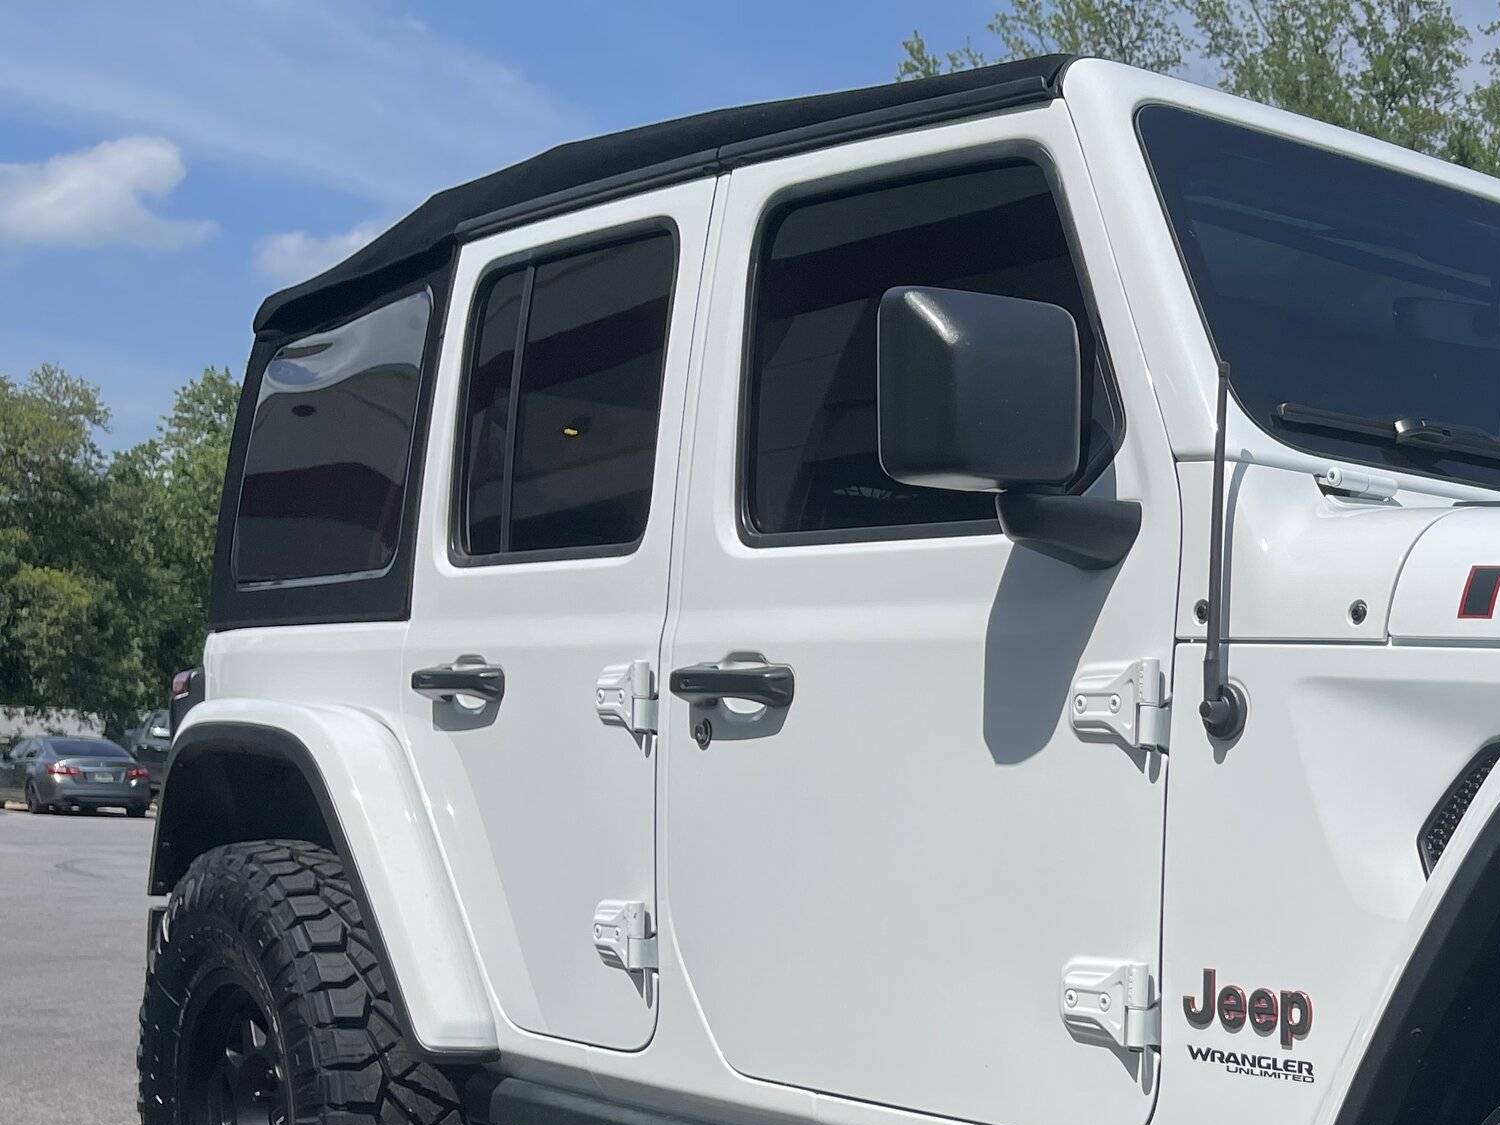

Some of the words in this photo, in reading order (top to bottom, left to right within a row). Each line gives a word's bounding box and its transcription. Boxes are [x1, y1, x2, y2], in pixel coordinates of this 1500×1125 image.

[1183, 968, 1313, 1049] Jeep
[1187, 1044, 1314, 1077] WRANGLER
[1226, 1065, 1315, 1084] UNLIMITED
